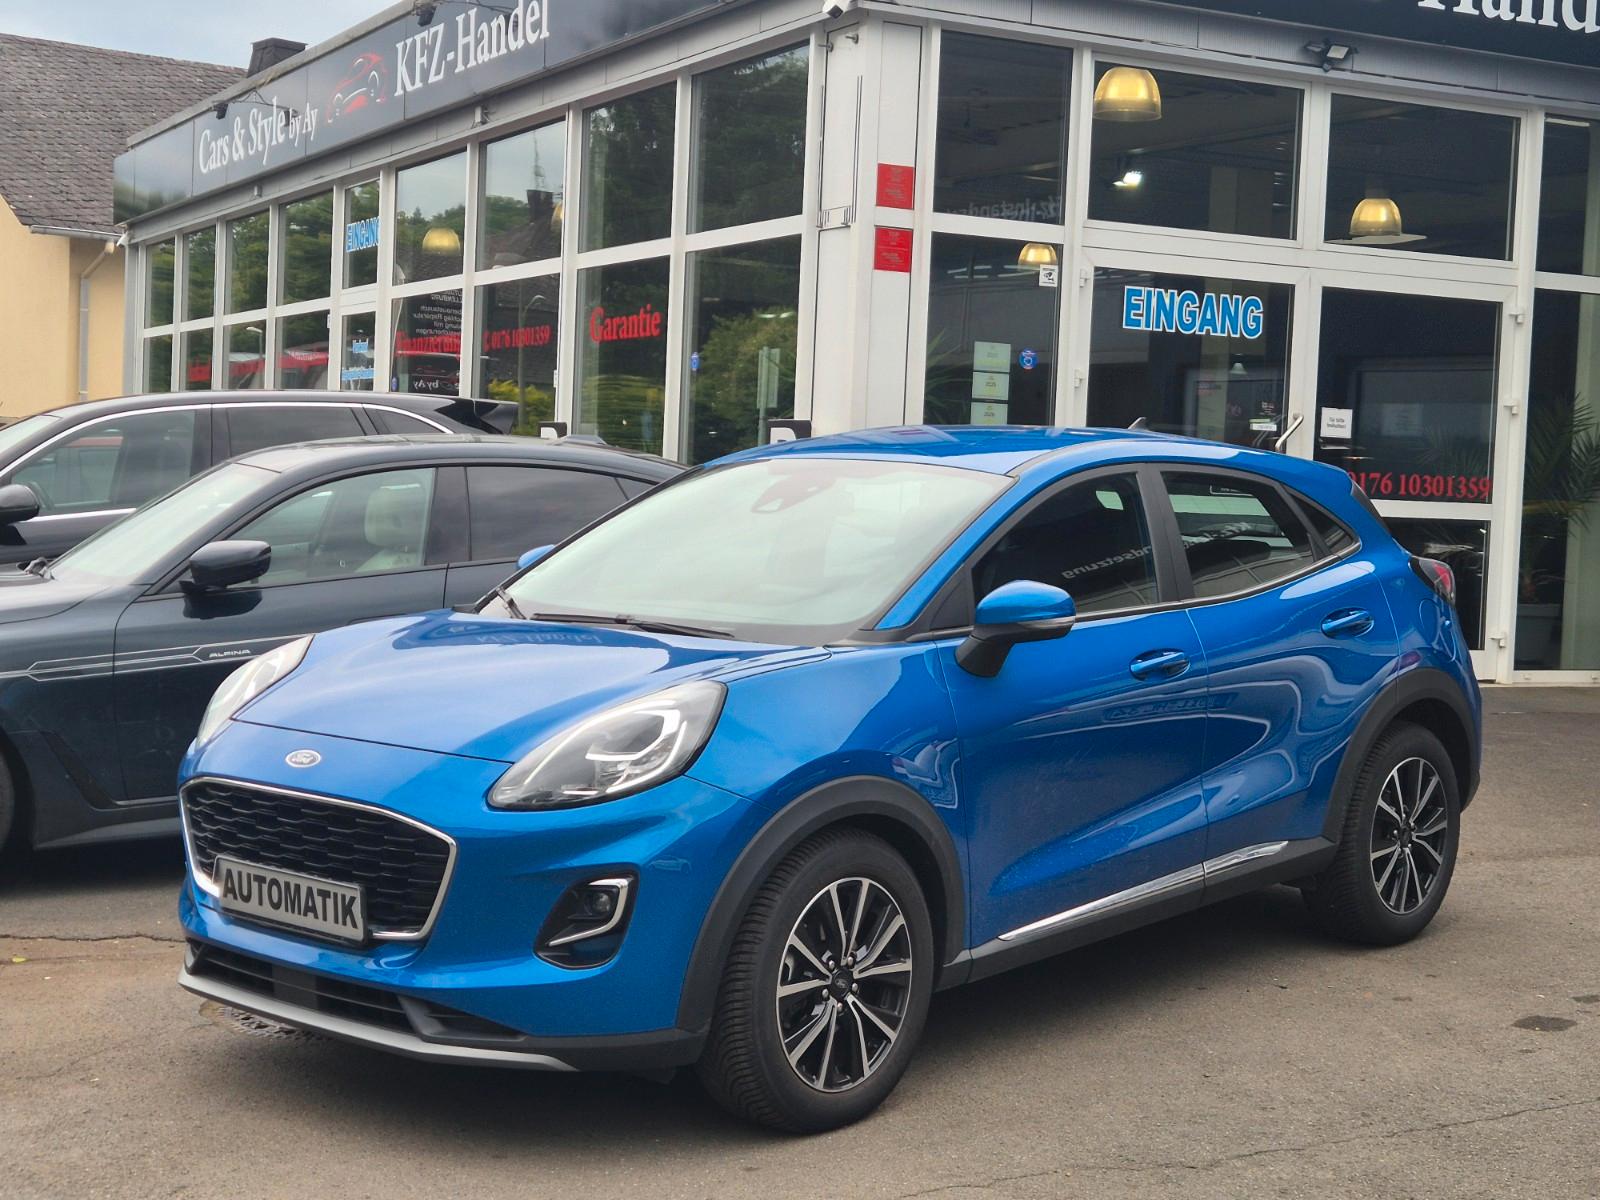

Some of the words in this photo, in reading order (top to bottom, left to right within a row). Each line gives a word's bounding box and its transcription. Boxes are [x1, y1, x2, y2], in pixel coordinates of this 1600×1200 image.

[394, 0, 549, 96] KFZ-Handel
[198, 129, 229, 173] Cars
[232, 116, 245, 161] &
[248, 96, 286, 165] Style
[289, 107, 301, 146] by
[302, 102, 318, 140] Ay
[589, 304, 662, 343] Garantie
[1123, 285, 1264, 340] EINGANG
[1398, 474, 1491, 498] 10301359
[208, 649, 251, 658] ALPINA
[222, 868, 358, 930] AUTOMATIK
